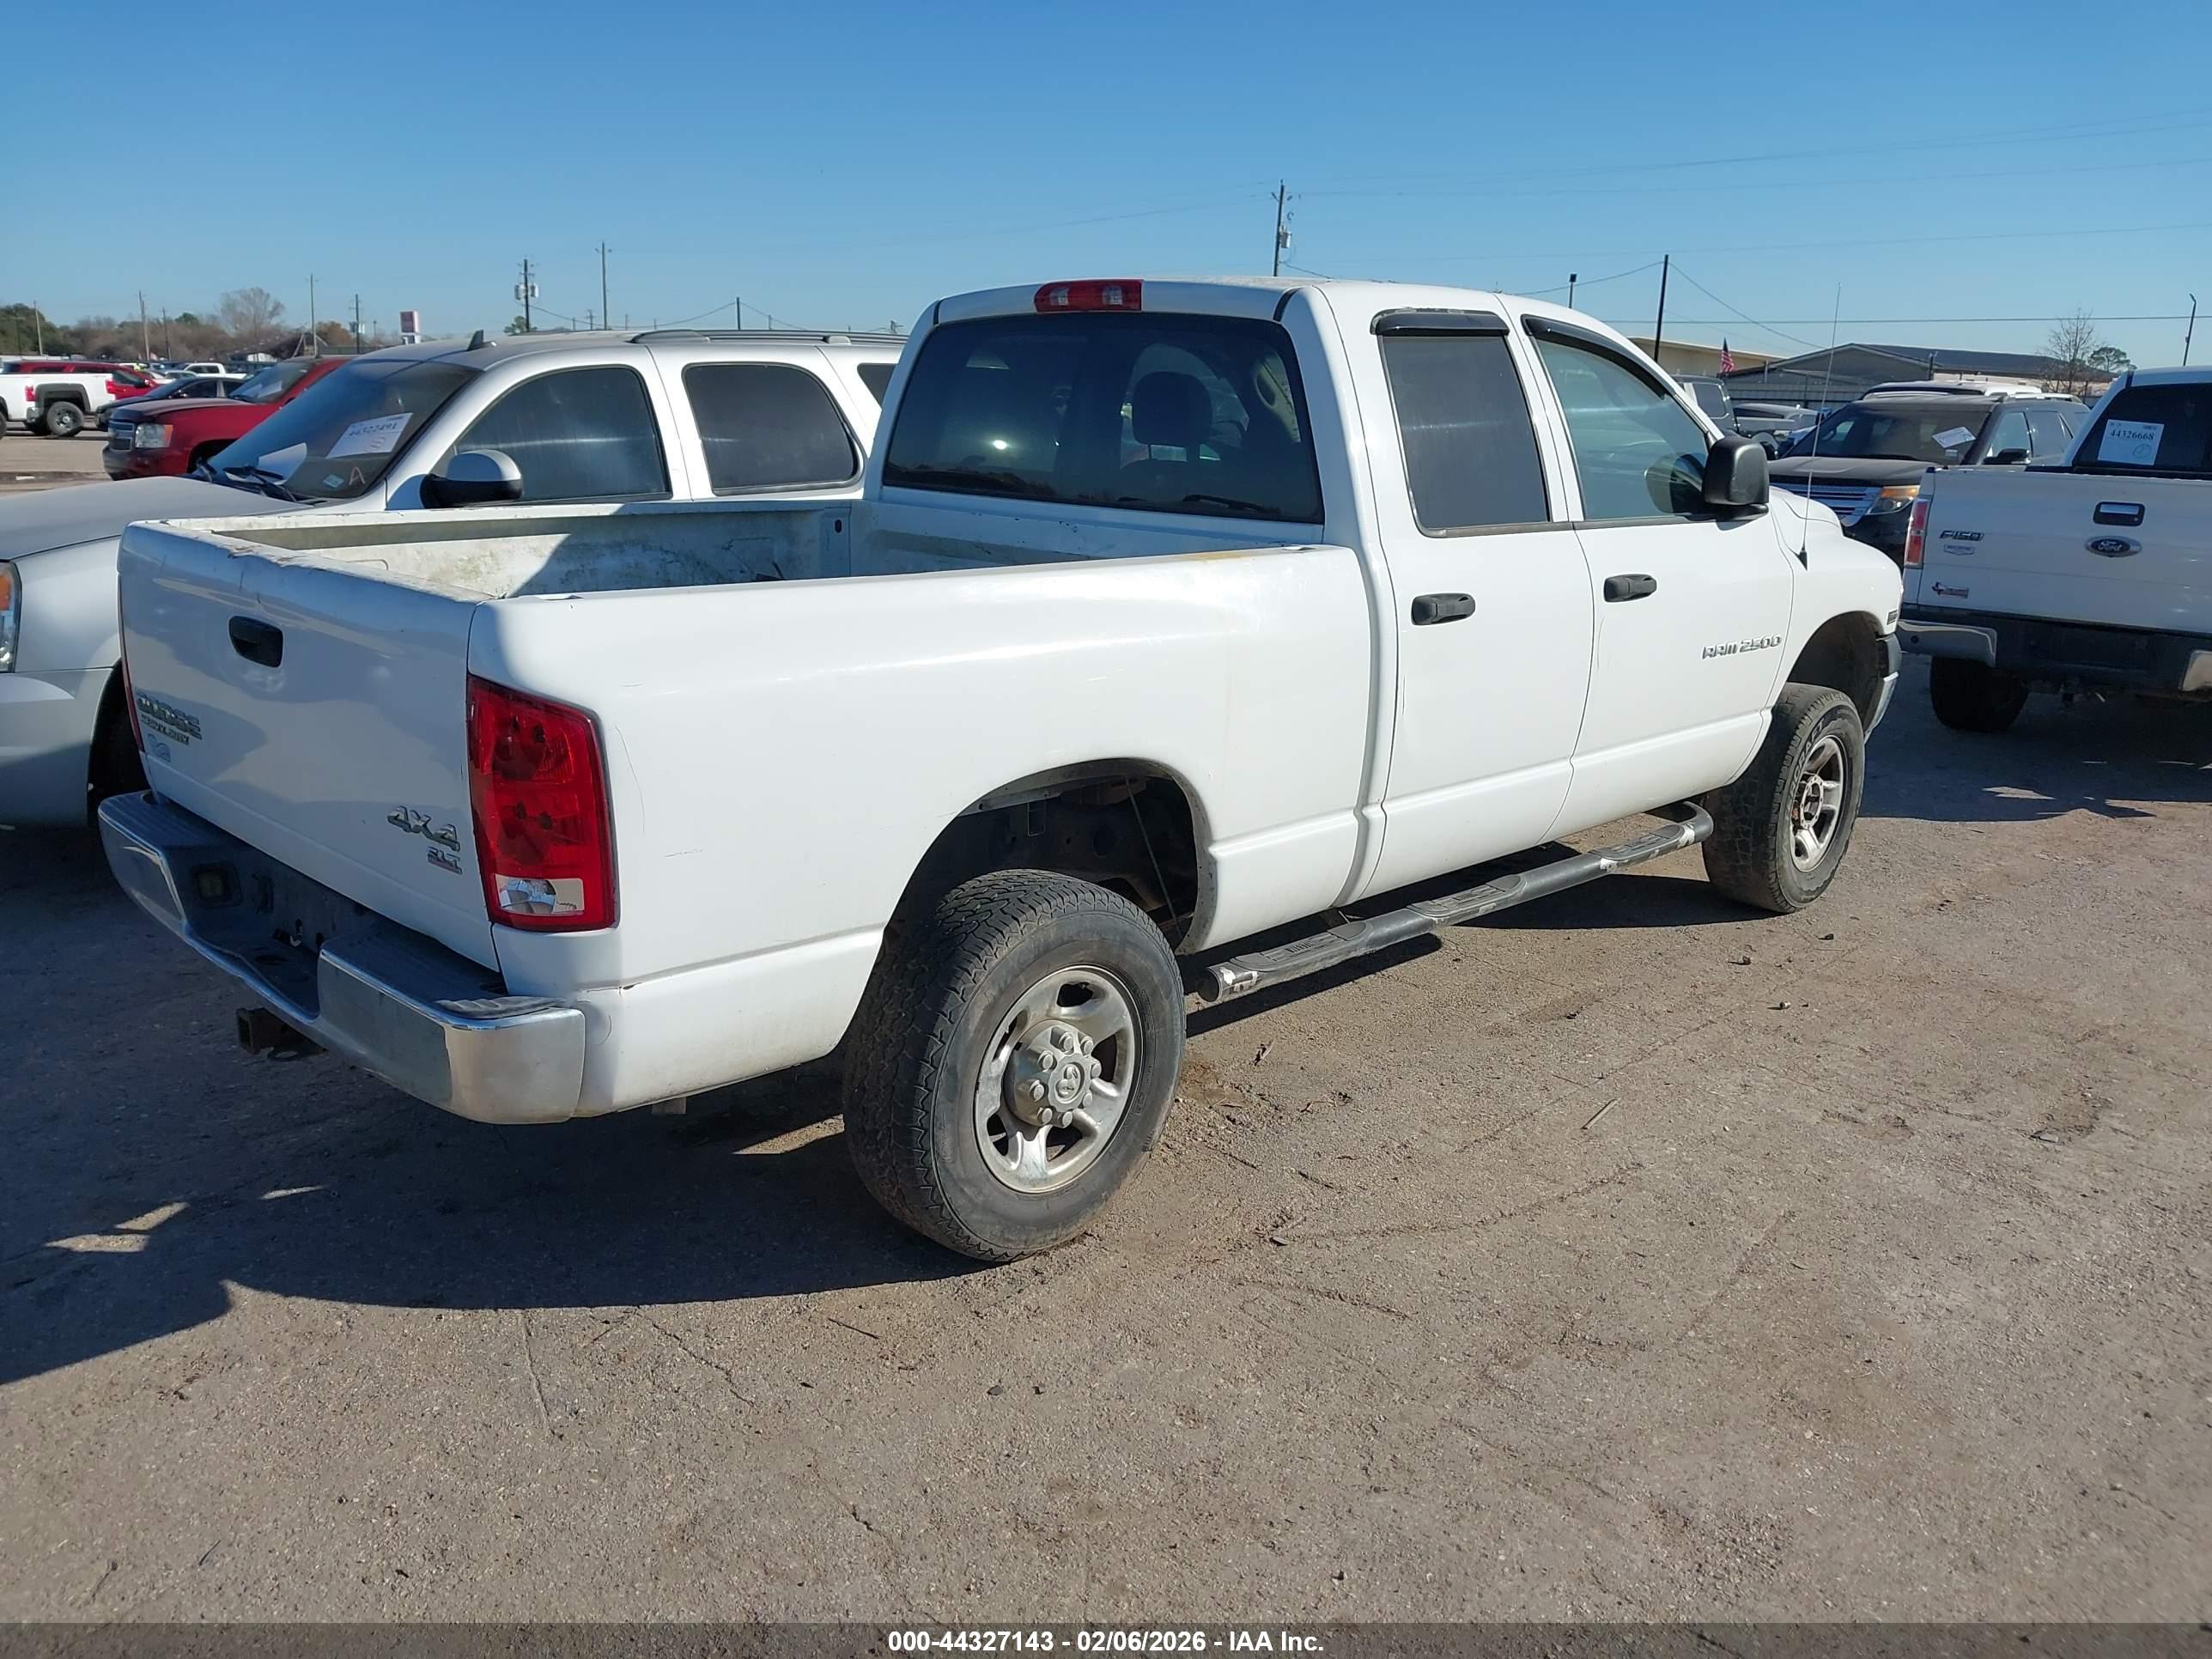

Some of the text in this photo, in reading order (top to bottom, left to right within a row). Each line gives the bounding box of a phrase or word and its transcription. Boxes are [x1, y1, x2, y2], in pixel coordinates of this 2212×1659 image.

[2110, 429, 2155, 441] 44326668
[1702, 635, 1782, 659] RAM 2500
